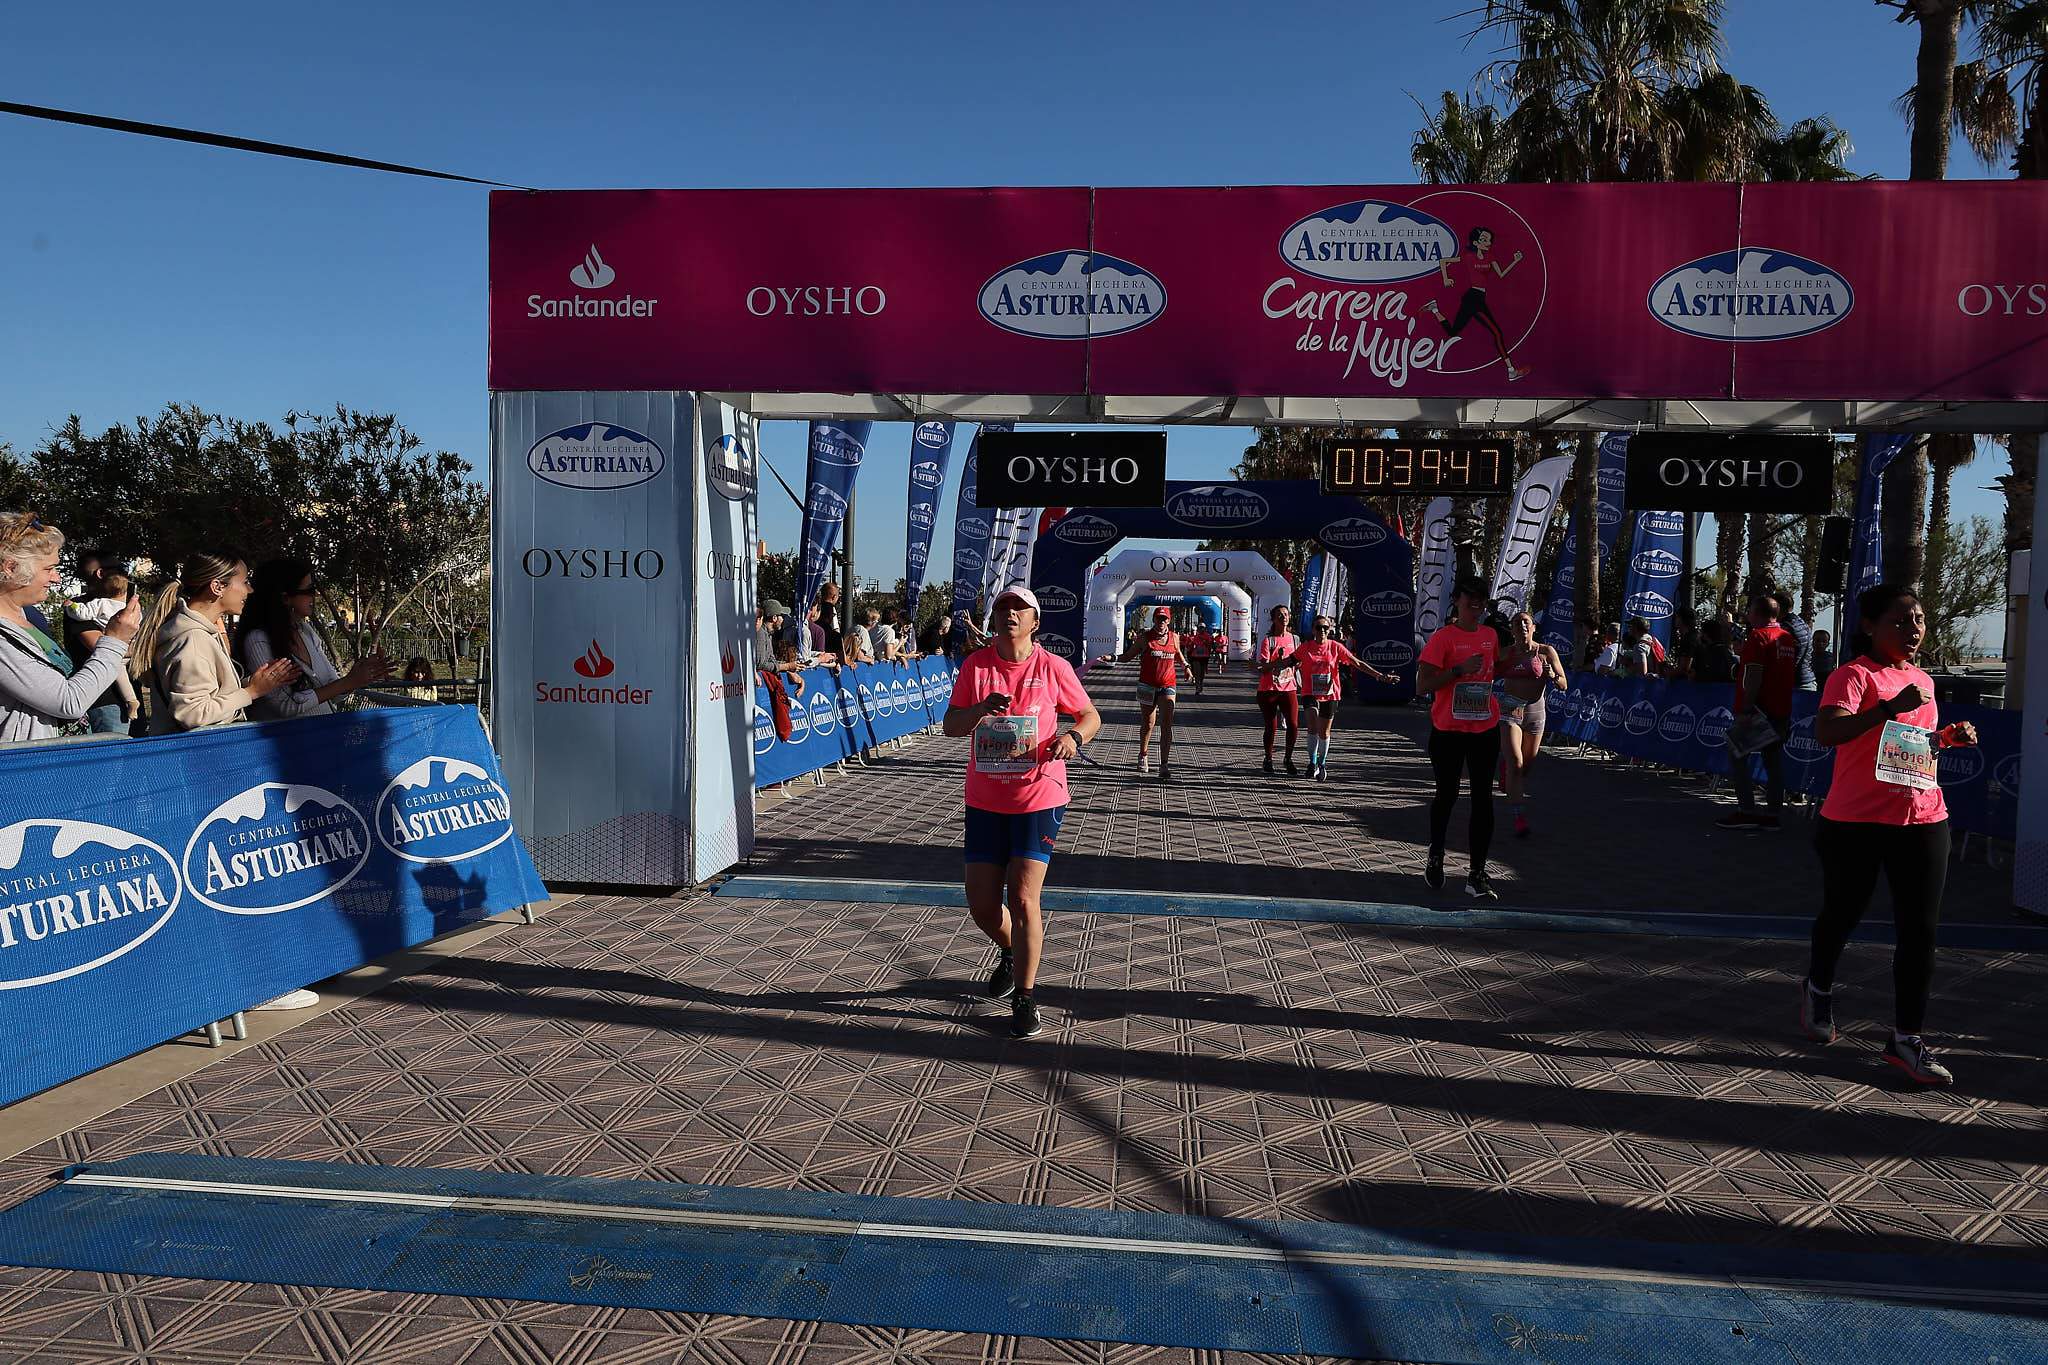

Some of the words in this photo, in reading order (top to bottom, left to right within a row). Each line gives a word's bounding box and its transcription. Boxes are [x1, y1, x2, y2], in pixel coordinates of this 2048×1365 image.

[1292, 230, 1443, 262] ASTURIANA
[1321, 228, 1377, 237] CENTRAL
[1382, 228, 1439, 237] LECHERA
[991, 283, 1152, 316] ASTURIANA
[1021, 281, 1080, 290] CENTRAL
[1262, 277, 1408, 321] Carrera
[1663, 282, 1837, 317] ASTURIANA
[1695, 279, 1763, 289] CENTRAL
[1765, 279, 1831, 289] LECHERA
[527, 294, 658, 318] Santander
[745, 285, 886, 316] OYSHO
[1957, 283, 2048, 317] OYS
[1295, 322, 1324, 352] de
[1328, 322, 1348, 352] la
[1342, 316, 1463, 388] Mujer
[537, 447, 655, 473] ASTURIANA
[1007, 455, 1139, 485] OYSHO
[1335, 448, 1499, 485] 00:39:47
[1659, 457, 1804, 489] OYSHO
[1174, 498, 1262, 518] ASTURIANA
[1058, 524, 1112, 538] ASTURIANA
[1324, 530, 1384, 543] ASTURIANA
[522, 548, 664, 580] OYSHO
[707, 550, 751, 582] OYSHO
[1150, 556, 1230, 574] OYSHO
[1418, 518, 1451, 634] OYSHO
[1635, 557, 1679, 574] ASTURIANA
[536, 682, 653, 705] Santander
[405, 791, 452, 808] CENTRAL
[228, 824, 289, 847] CENTRAL
[294, 811, 349, 833] LECHERA
[392, 797, 510, 847] ASTURIANA
[68, 852, 151, 882] LECHERA
[204, 827, 363, 896] ASTURIANA
[0, 873, 169, 948] TURIANA
